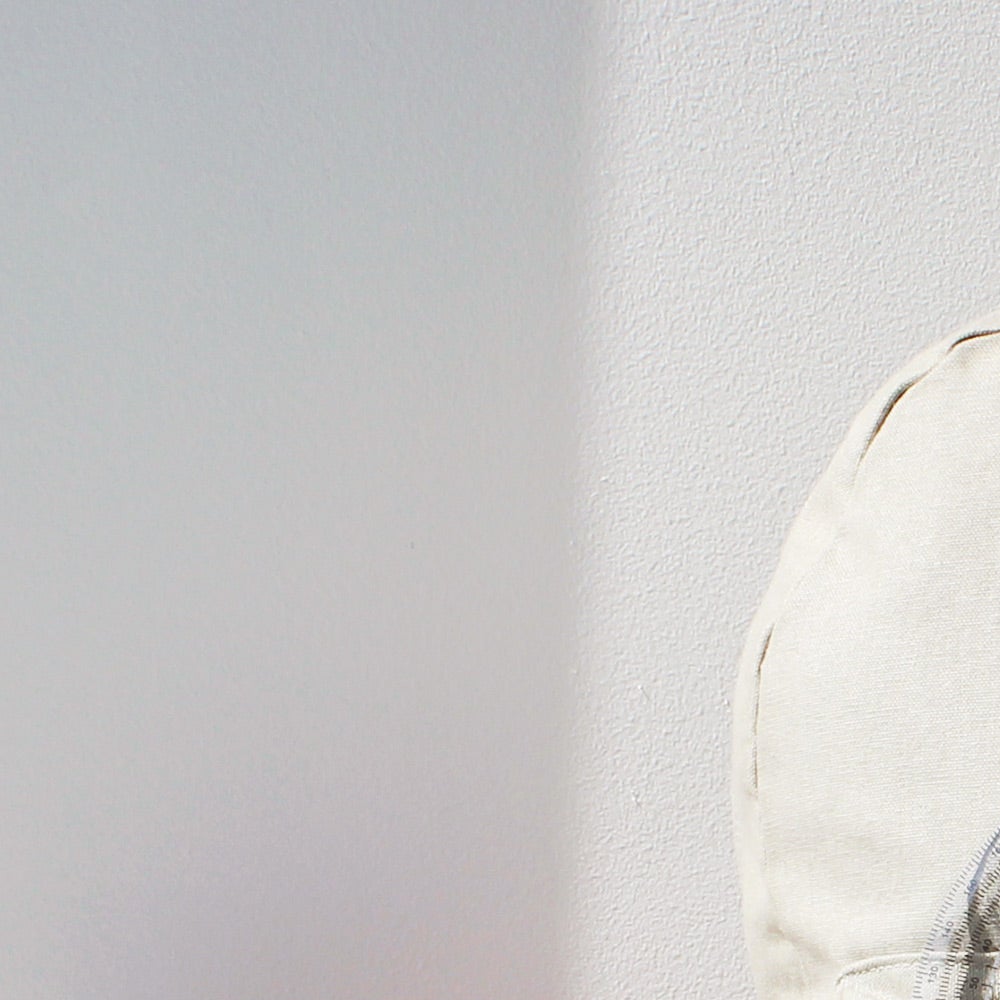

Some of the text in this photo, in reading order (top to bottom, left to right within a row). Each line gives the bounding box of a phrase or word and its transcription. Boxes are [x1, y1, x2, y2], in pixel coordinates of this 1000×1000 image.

[941, 921, 954, 938] 140
[982, 939, 993, 952] 40
[927, 966, 939, 983] 130
[969, 977, 979, 989] 50
